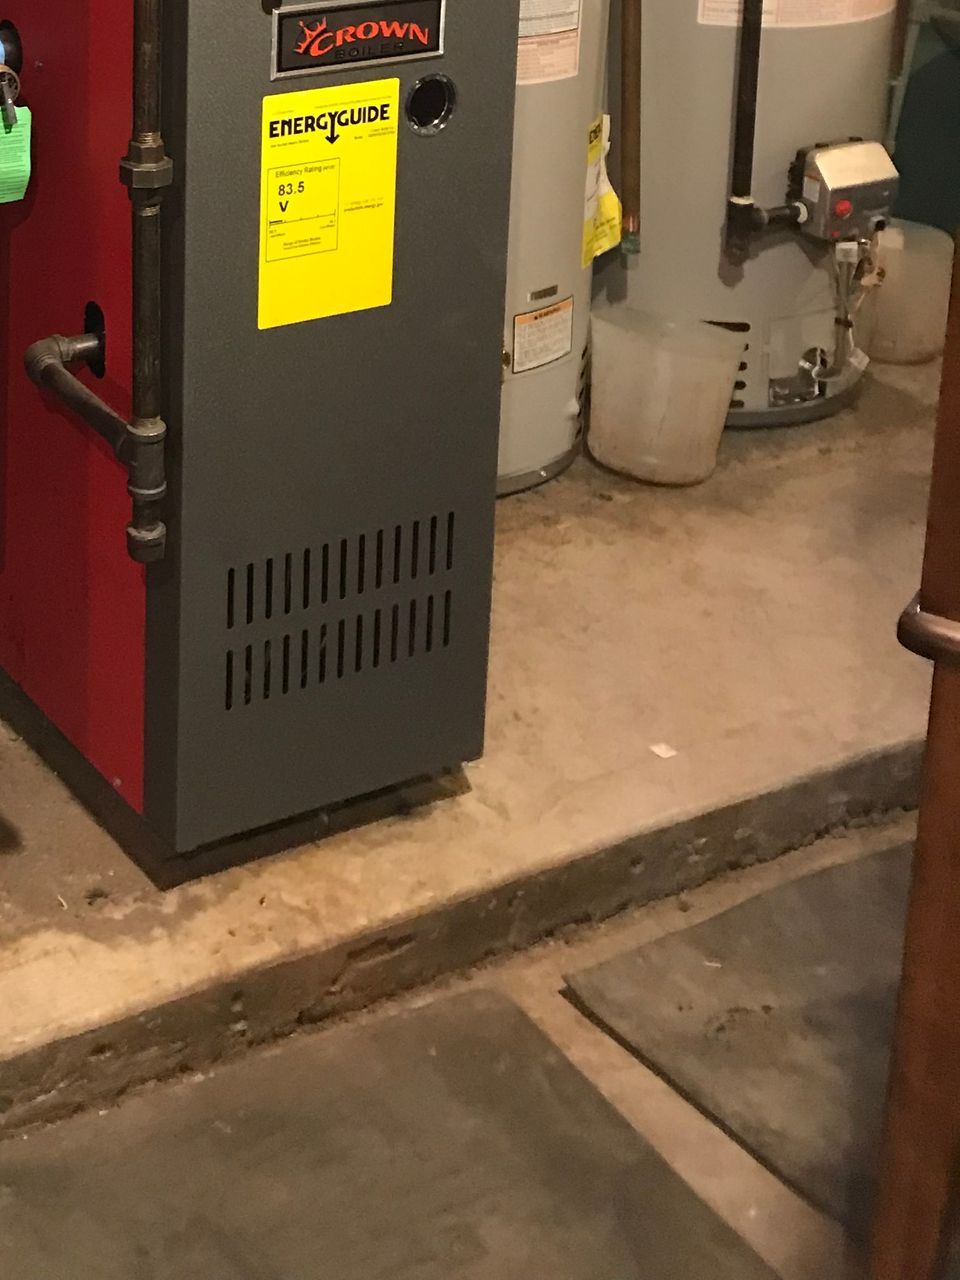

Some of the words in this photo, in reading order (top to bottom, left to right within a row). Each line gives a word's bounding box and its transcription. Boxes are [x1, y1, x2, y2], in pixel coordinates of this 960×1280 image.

[309, 20, 429, 57] CROWN
[334, 41, 405, 59] BOILER
[269, 103, 390, 144] ENERGYGUIDE
[275, 168, 302, 178] Efficiency
[304, 165, 322, 174] Rating
[278, 181, 305, 196] 83.5
